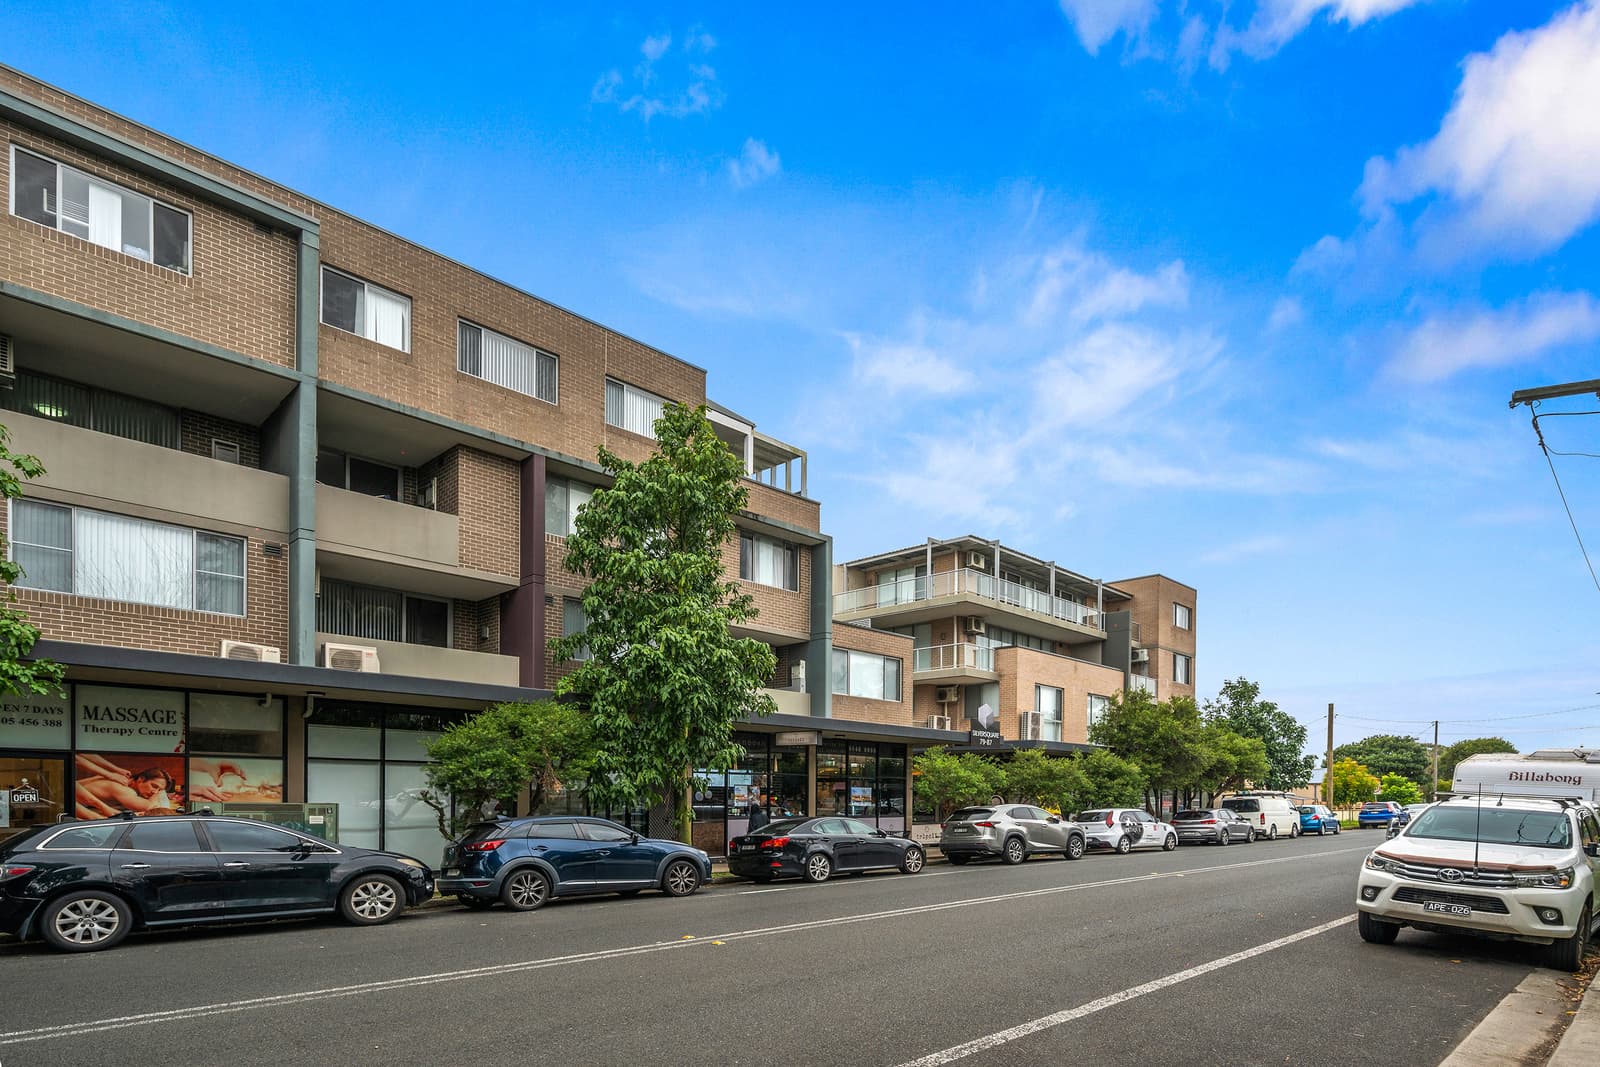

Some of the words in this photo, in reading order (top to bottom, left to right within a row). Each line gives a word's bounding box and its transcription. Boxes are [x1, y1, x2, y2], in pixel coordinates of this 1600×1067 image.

[0, 704, 20, 712] EN
[32, 706, 64, 715] DAYS
[83, 705, 177, 724] MASSAGE
[18, 718, 39, 727] 456
[41, 719, 63, 728] 388
[82, 724, 135, 736] Therapy
[138, 727, 178, 736] Centre
[1509, 771, 1583, 785] Billabong
[13, 794, 37, 802] OPEN
